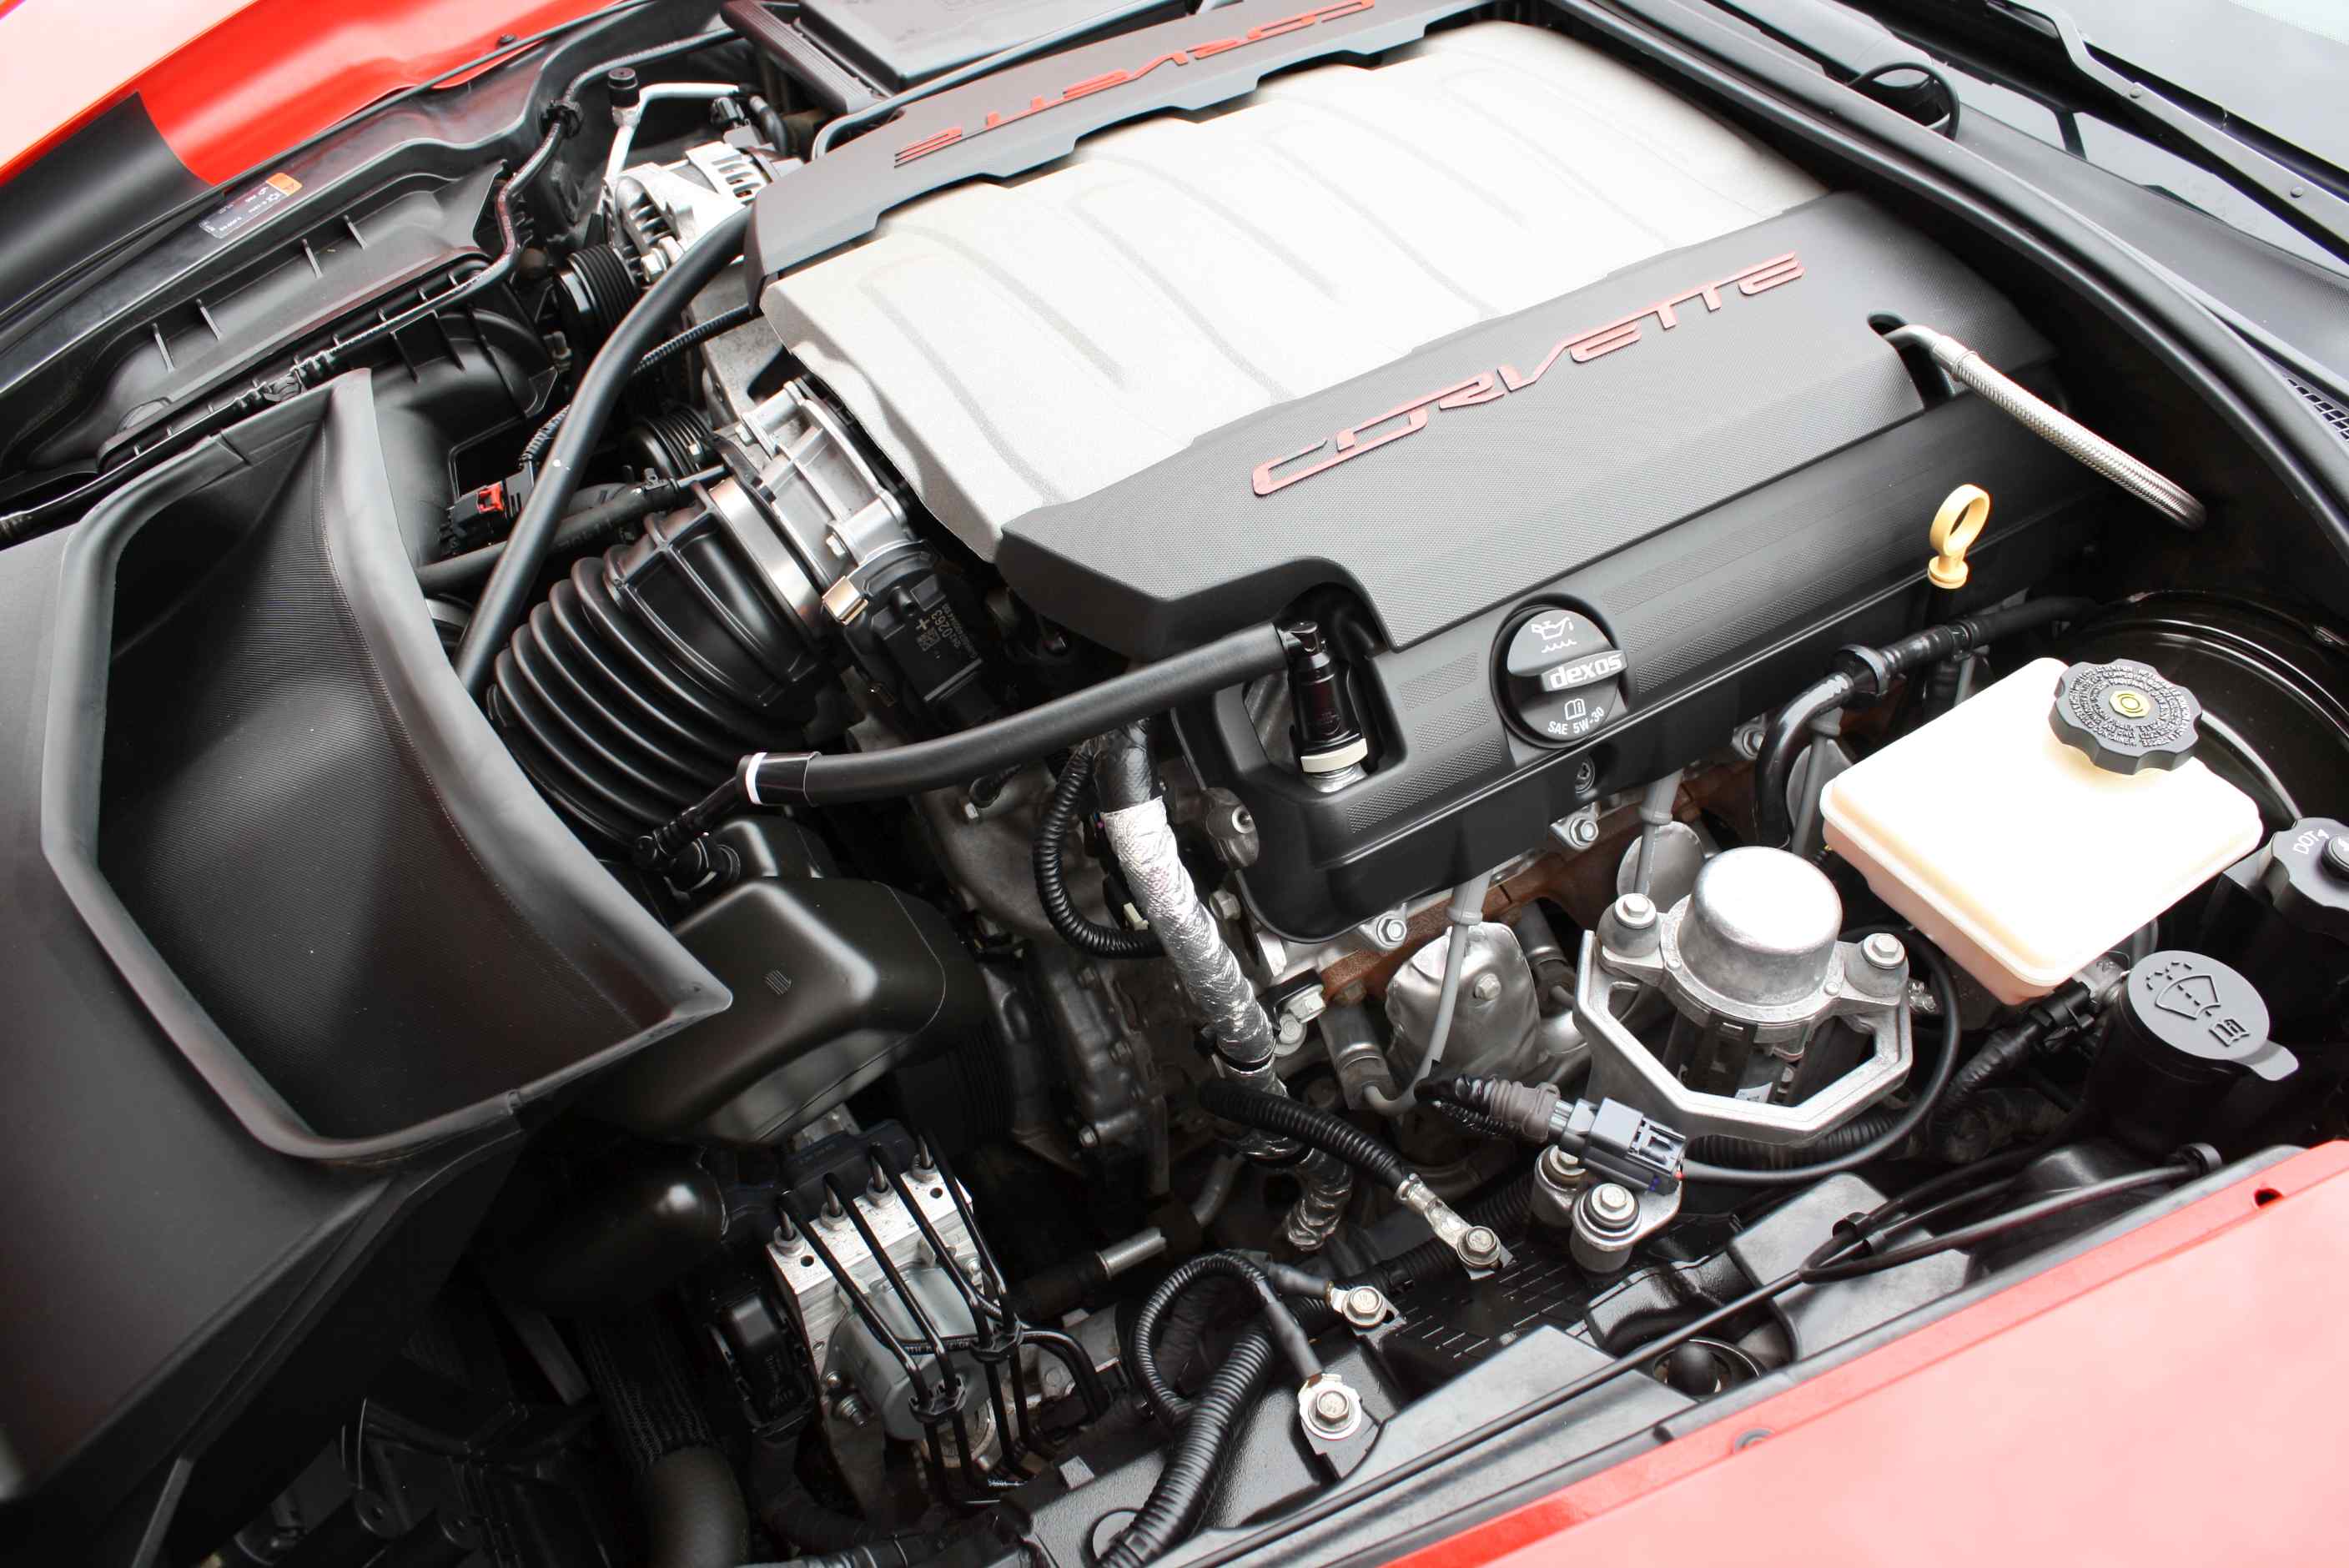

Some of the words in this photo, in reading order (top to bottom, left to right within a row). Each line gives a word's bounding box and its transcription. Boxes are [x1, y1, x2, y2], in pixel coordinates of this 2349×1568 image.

[1252, 251, 1805, 496] CORVETTE
[1550, 653, 1622, 689] dexos
[1548, 721, 1568, 735] SAE
[1573, 706, 1605, 734] 5W-30
